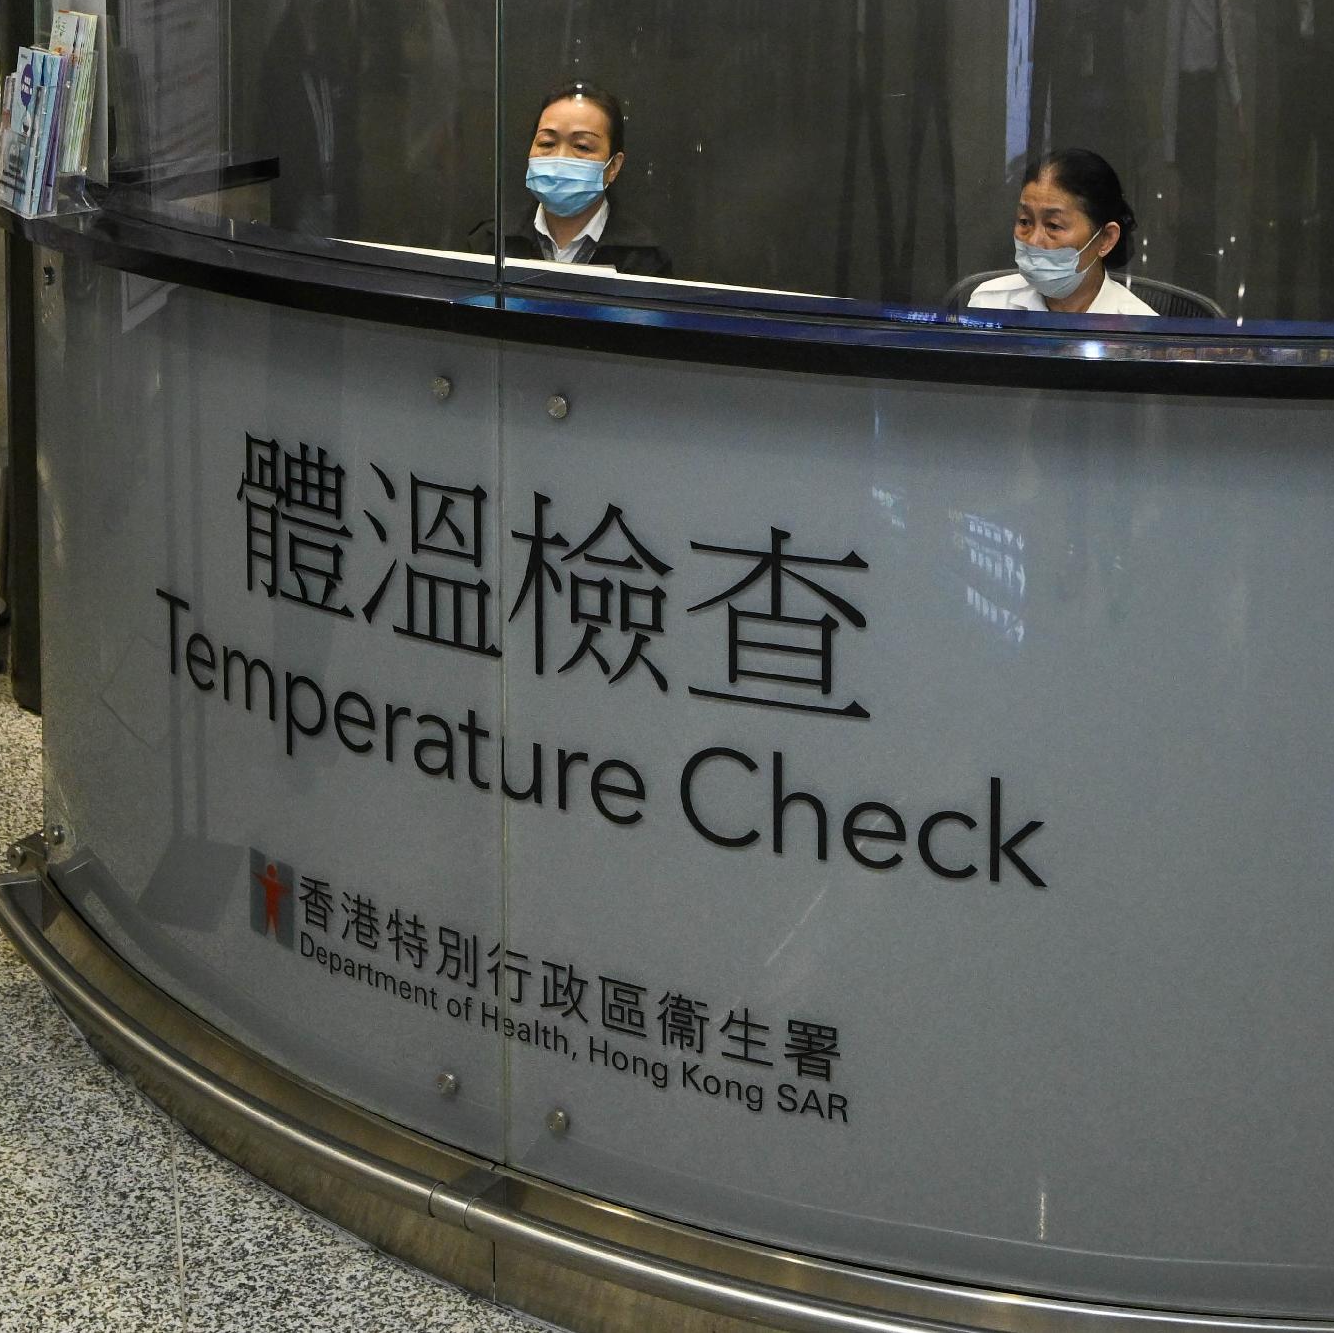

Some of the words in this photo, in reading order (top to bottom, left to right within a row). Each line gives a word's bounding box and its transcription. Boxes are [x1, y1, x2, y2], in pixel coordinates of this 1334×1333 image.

[236, 431, 871, 722] 體溫檢查
[156, 589, 646, 827] Temperature
[679, 747, 1047, 888] Check
[300, 932, 440, 1011] Department
[447, 995, 474, 1020] of
[481, 1006, 578, 1062] Health,
[590, 1036, 670, 1089] Hong
[682, 1063, 765, 1112] Kong
[777, 1082, 849, 1124] SAR
